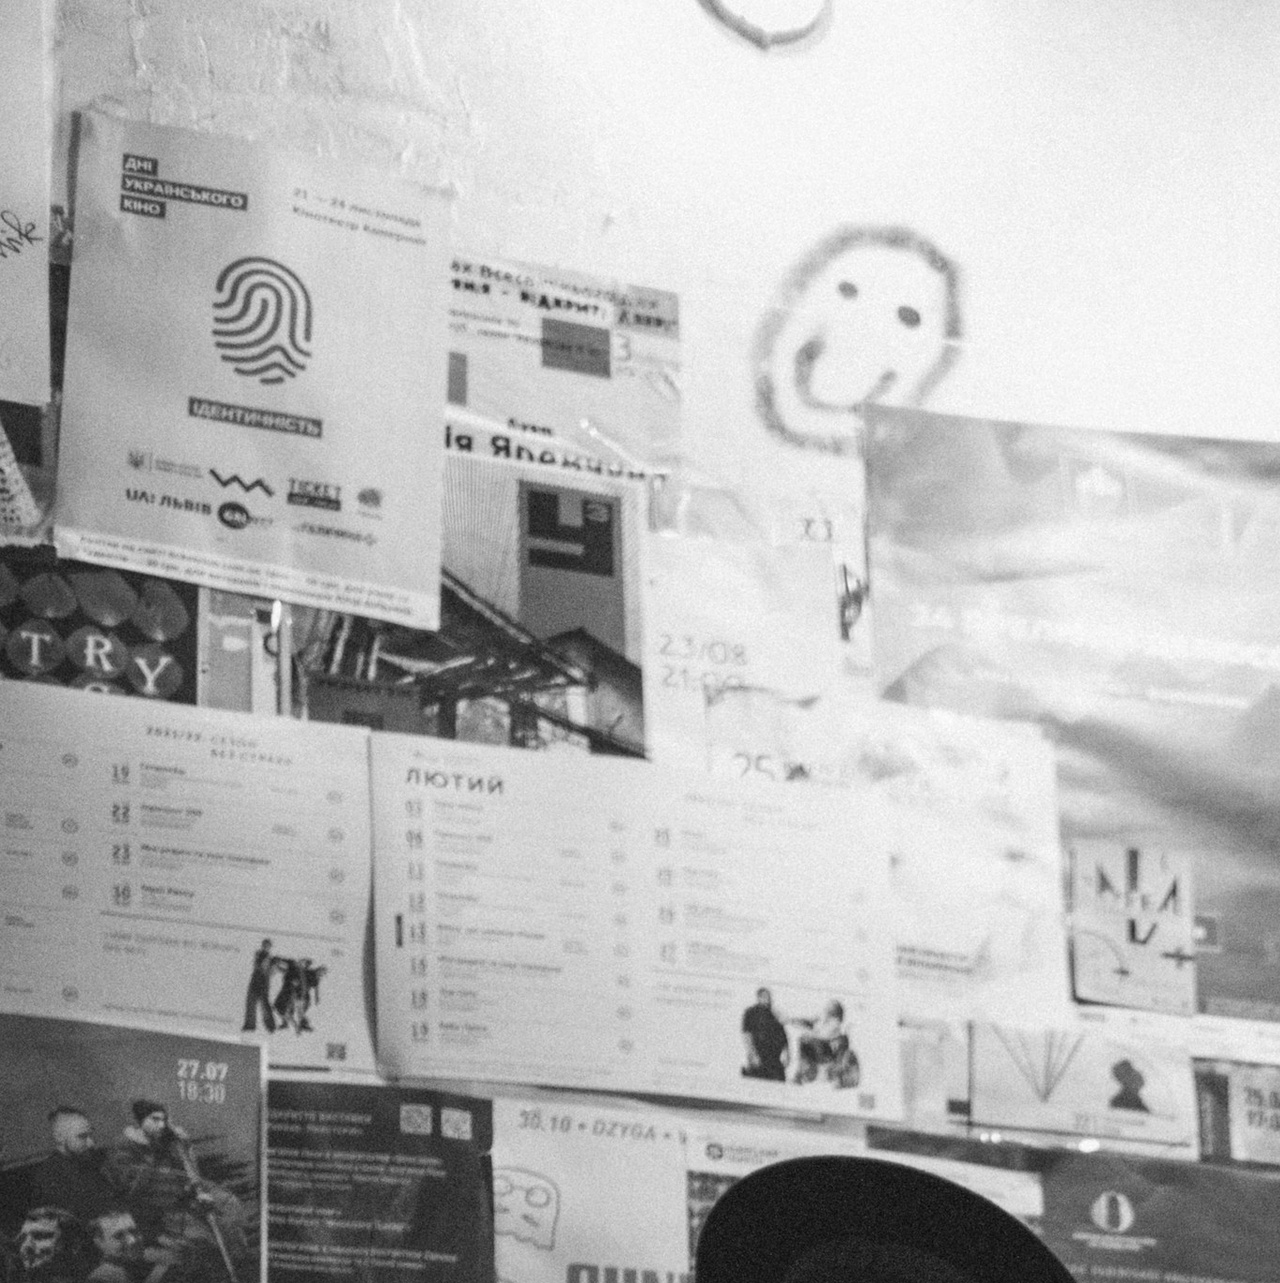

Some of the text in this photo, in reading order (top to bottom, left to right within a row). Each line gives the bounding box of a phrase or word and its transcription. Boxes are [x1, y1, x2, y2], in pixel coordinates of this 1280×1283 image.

[125, 157, 153, 173] ДНІ
[124, 177, 244, 208] УКРАЇНСЬКОГО
[122, 197, 161, 216] КІНО
[405, 766, 505, 796] ЛЮТИЙ
[592, 1118, 657, 1140] DZYGA
